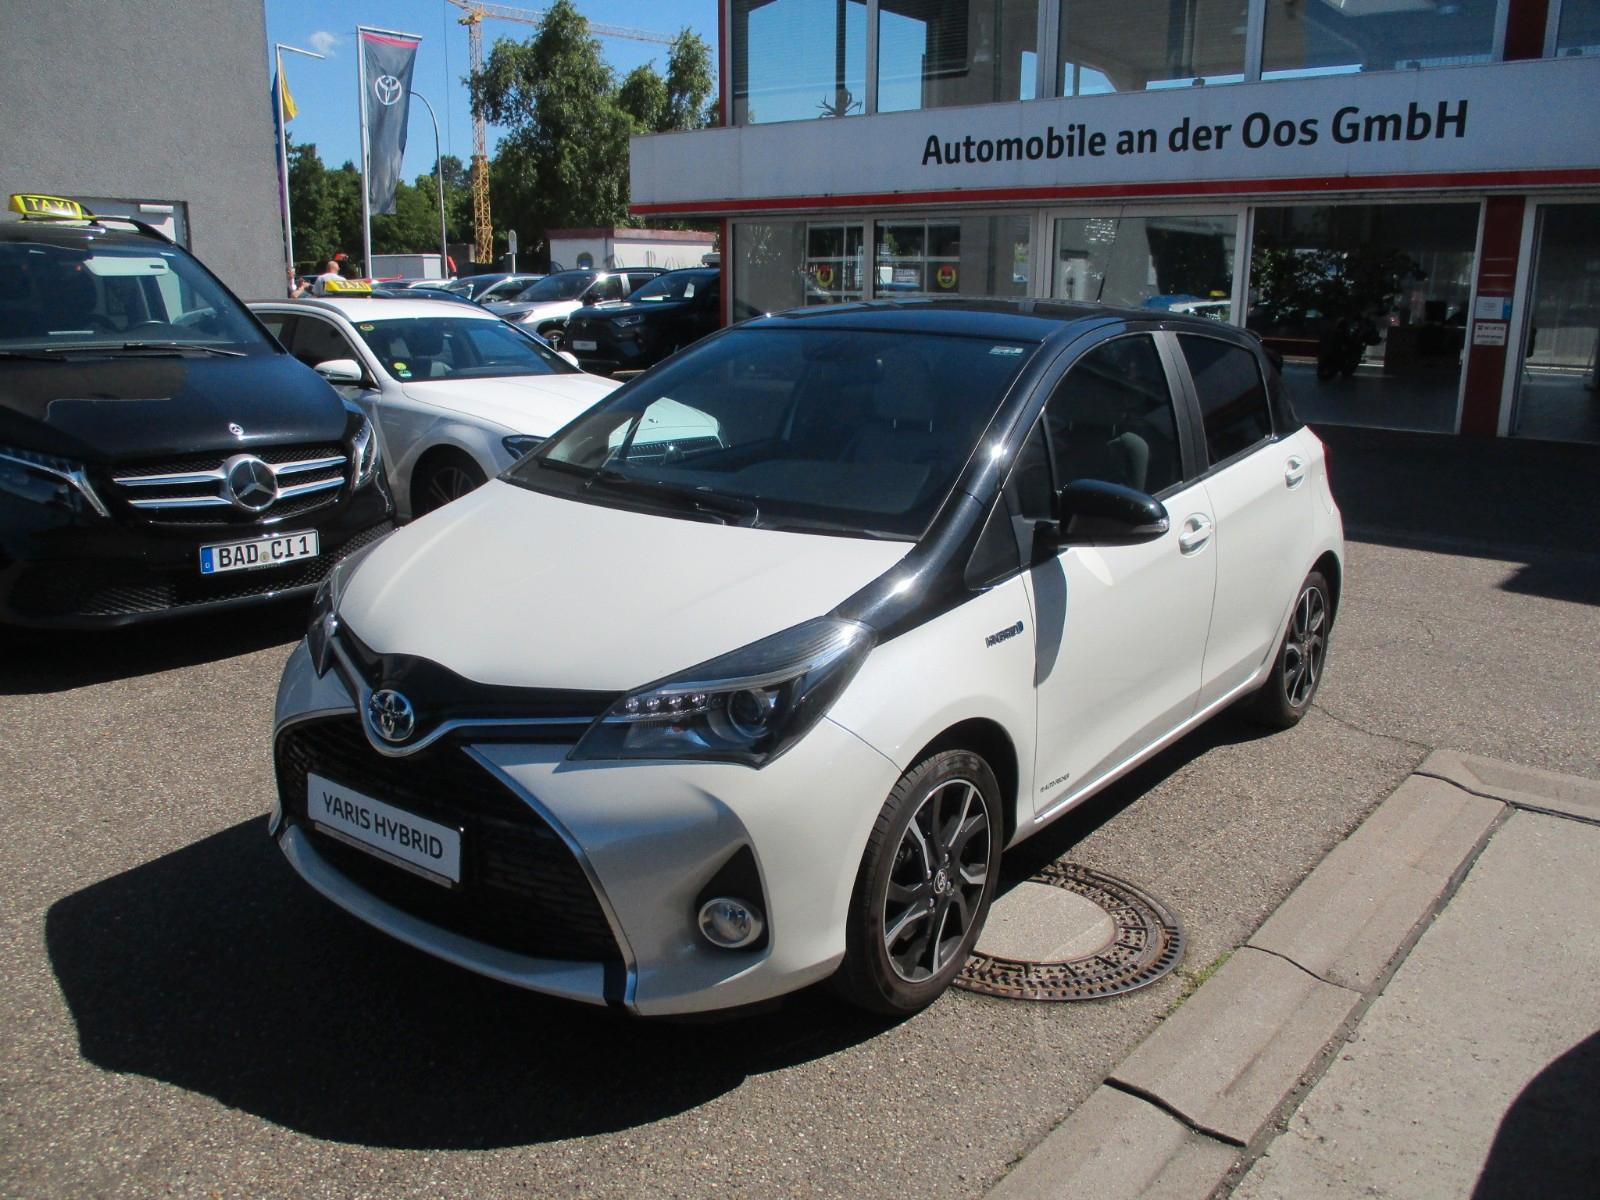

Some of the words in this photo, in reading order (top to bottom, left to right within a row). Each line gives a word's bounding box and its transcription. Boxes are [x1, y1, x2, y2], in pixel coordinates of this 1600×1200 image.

[922, 123, 1107, 166] Automobile
[1115, 132, 1159, 154] an
[1168, 117, 1233, 152] der
[1242, 113, 1319, 148] Oos
[1331, 100, 1469, 144] GmbH
[27, 197, 74, 216] TAXI
[336, 281, 369, 290] TAXI
[219, 544, 259, 568] BAD
[322, 791, 371, 829] YARIS
[374, 813, 443, 859] HYBRID
